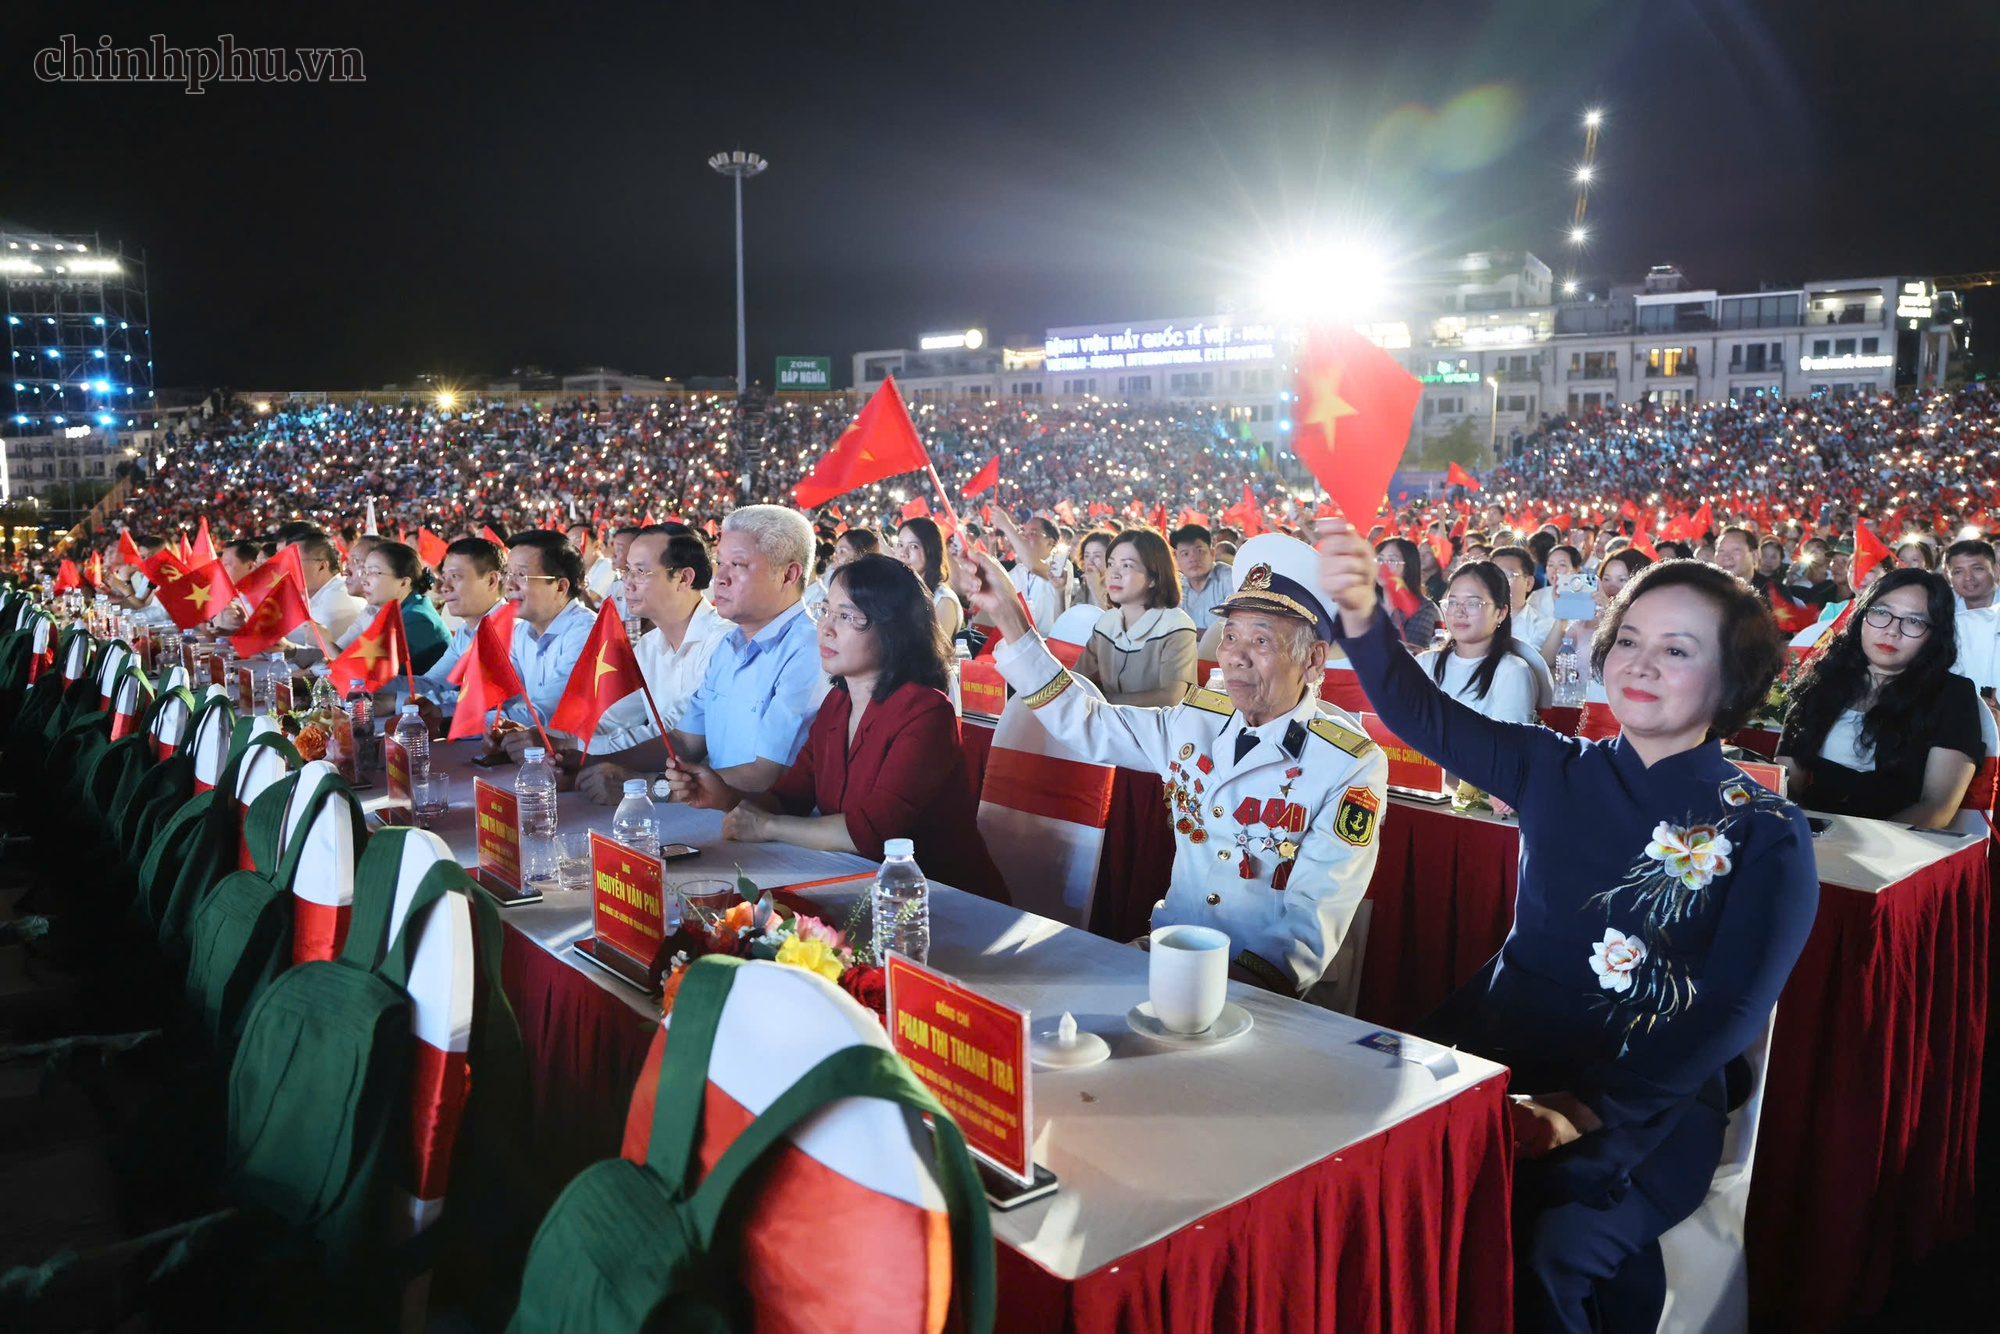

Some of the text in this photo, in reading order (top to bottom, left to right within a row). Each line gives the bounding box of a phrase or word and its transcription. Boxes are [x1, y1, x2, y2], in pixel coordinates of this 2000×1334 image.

[597, 870, 625, 901] NGUYỄN
[626, 883, 642, 910] VĂN
[898, 1009, 929, 1049] PHẠM
[931, 1027, 949, 1066] THỊ
[951, 1037, 989, 1081] THANH
